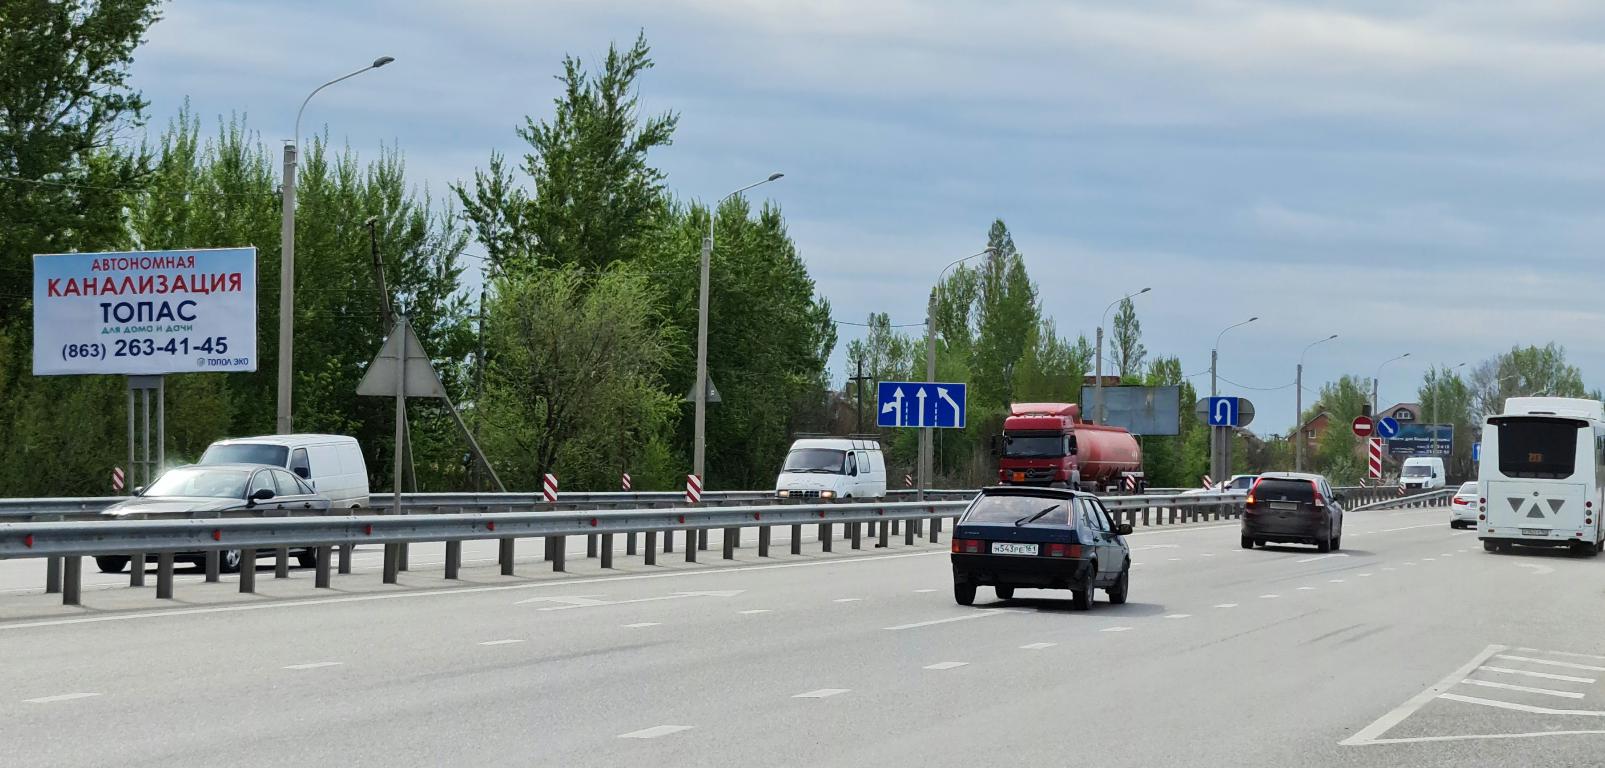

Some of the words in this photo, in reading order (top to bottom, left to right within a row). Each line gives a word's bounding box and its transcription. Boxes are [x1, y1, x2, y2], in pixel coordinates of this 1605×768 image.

[91, 255, 195, 272] АВТОНОМНАЯ
[47, 272, 242, 297] КАНАЛИЗАЦИЯ
[99, 299, 197, 324] ТОПАС
[101, 326, 121, 335] для
[156, 324, 163, 332] и
[165, 323, 193, 333] дачи
[62, 343, 107, 361] (863)
[114, 336, 228, 357] 263-41-45
[207, 357, 232, 366] ТОПОЛ
[233, 357, 249, 366] ЭКО
